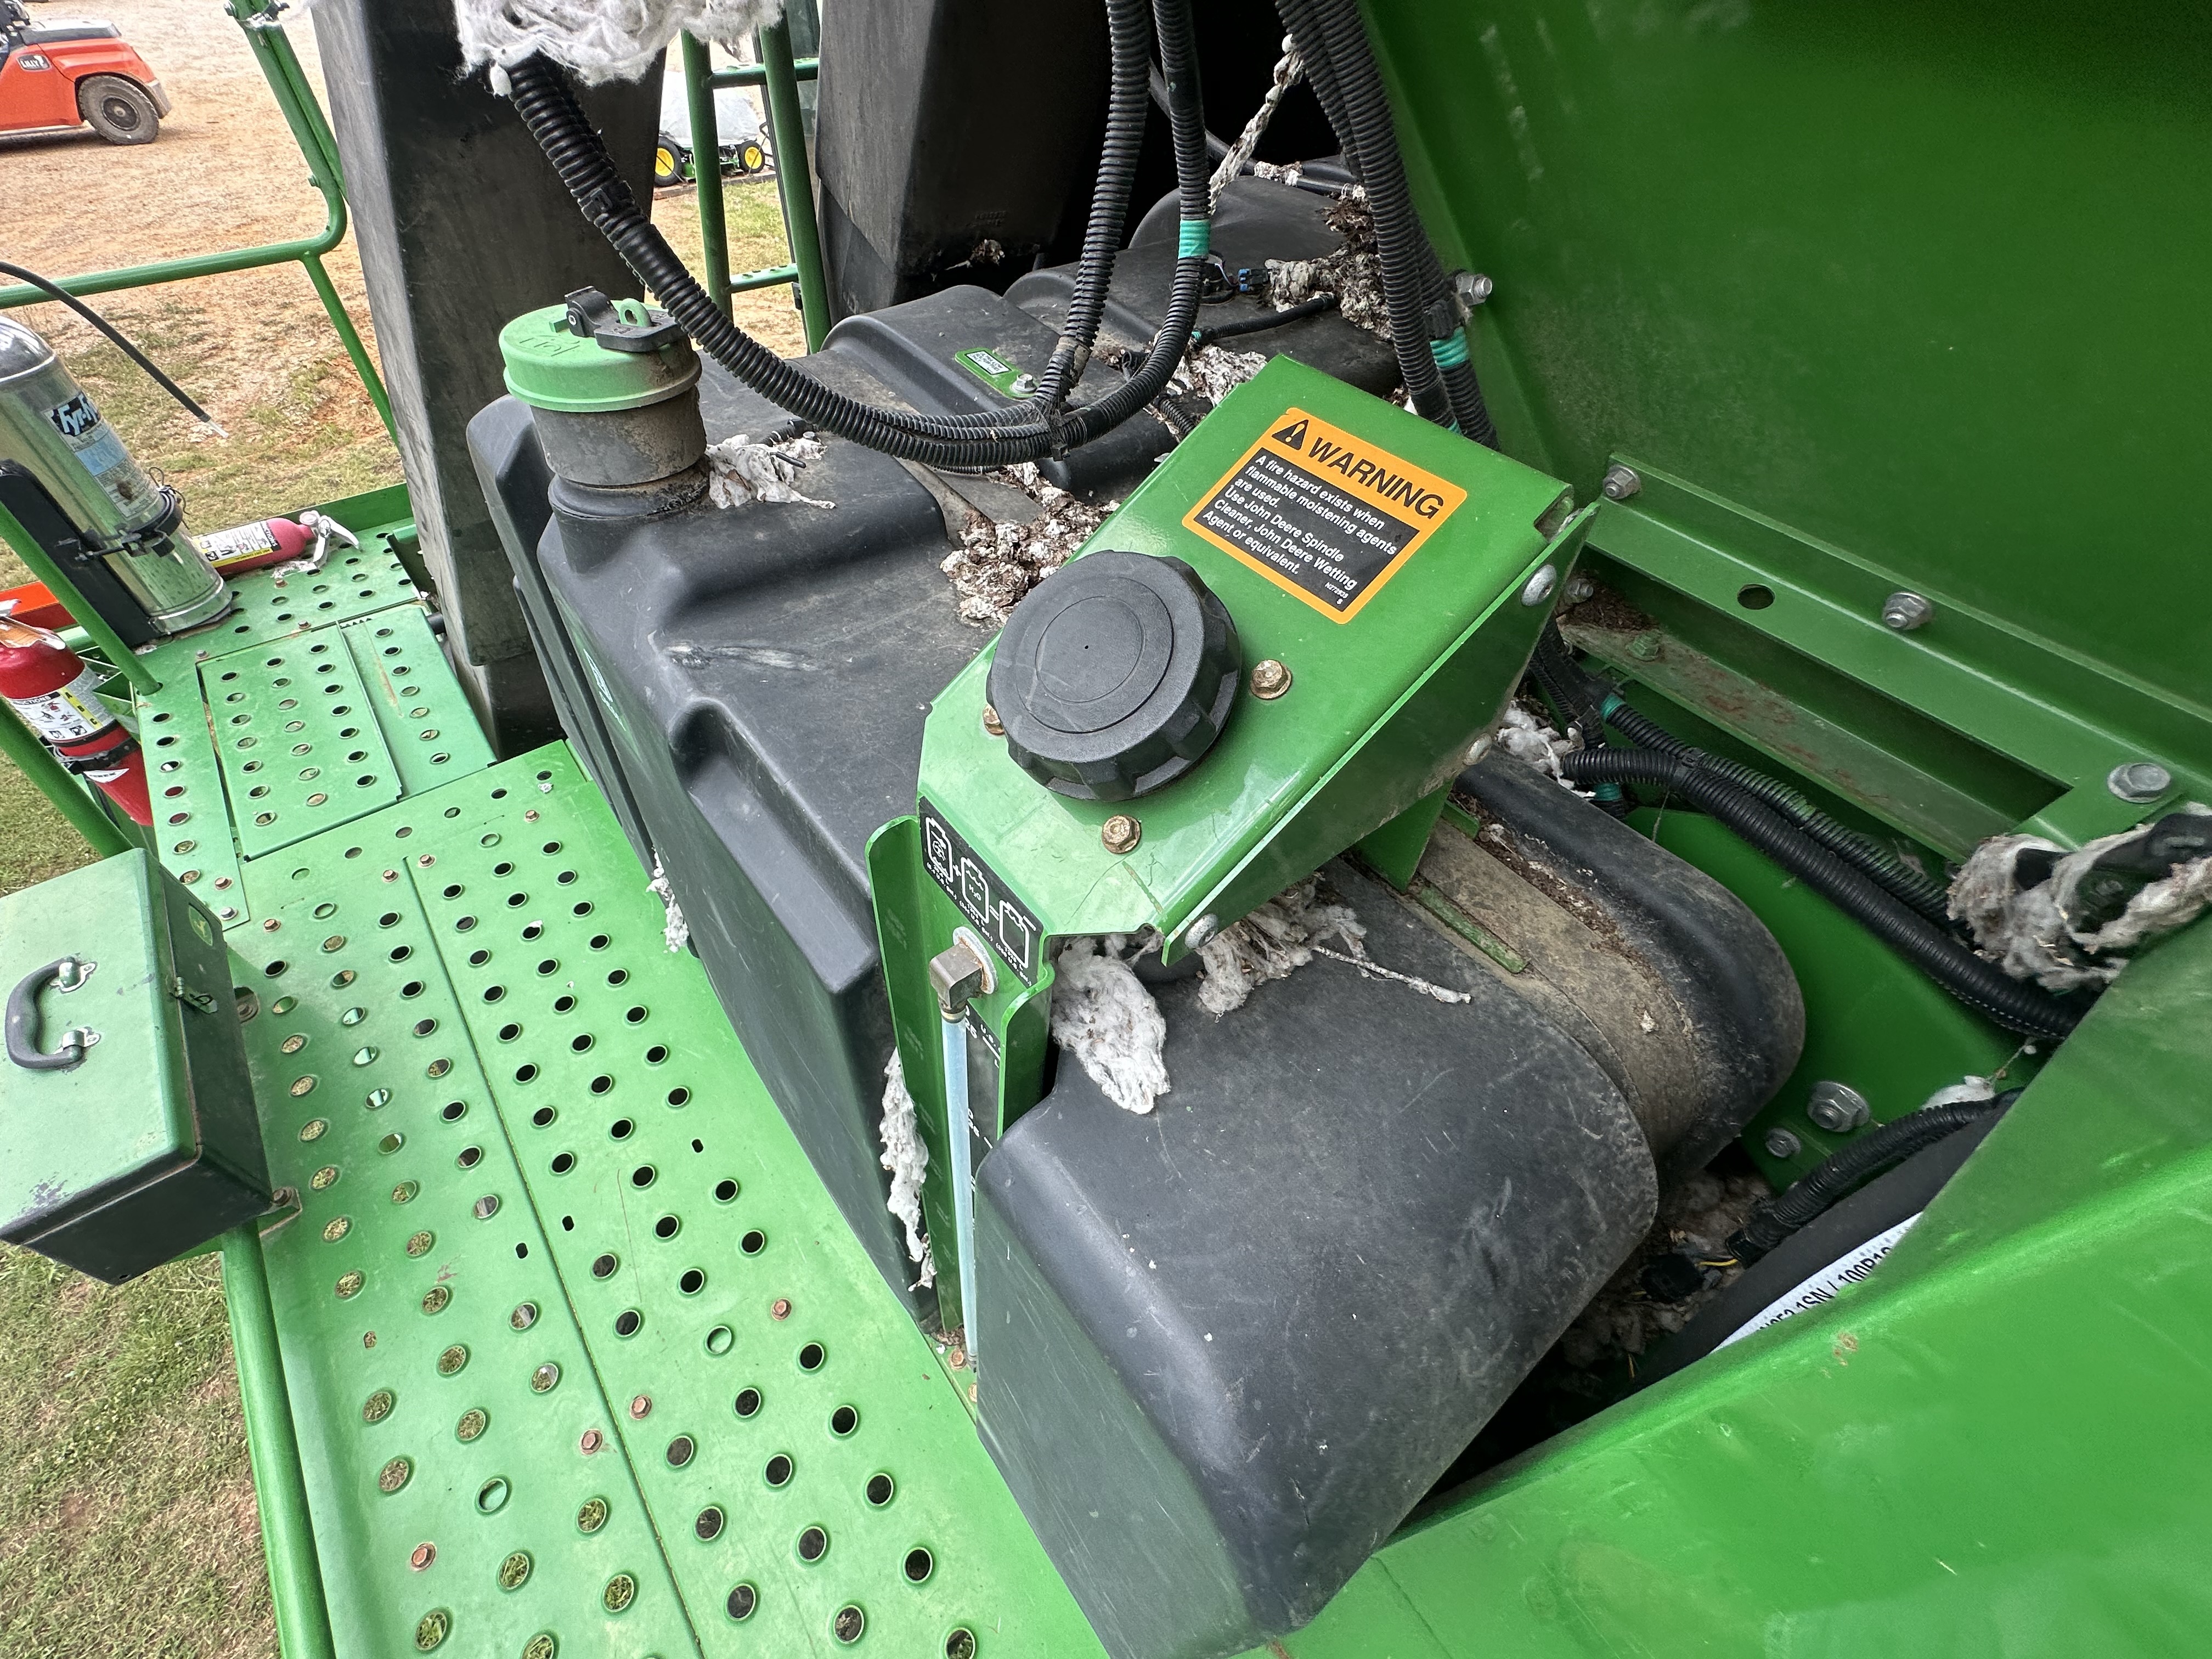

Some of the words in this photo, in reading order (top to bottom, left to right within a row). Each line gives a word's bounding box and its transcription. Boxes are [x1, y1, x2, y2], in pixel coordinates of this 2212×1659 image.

[1234, 478, 1252, 492] are
[1251, 487, 1281, 508] used.
[1245, 465, 1297, 500] flammable
[1296, 495, 1358, 535] moistening
[1356, 529, 1397, 555] agents
[1255, 455, 1267, 466] A
[1265, 460, 1284, 475] fire
[1283, 469, 1322, 495] hazard
[1319, 490, 1353, 512] exists
[1352, 507, 1385, 531] when
[1308, 437, 1444, 519] WARNING
[1203, 510, 1235, 534] Agent
[1232, 529, 1247, 540] or
[1244, 537, 1300, 574] equivalent.
[1214, 499, 1254, 529] Cleaner,
[1254, 523, 1282, 544] John
[1280, 538, 1313, 562] Deere
[1313, 556, 1358, 591] Wetting
[1224, 486, 1245, 505] Use
[1244, 500, 1272, 520] John
[1269, 514, 1302, 538] Deere
[1301, 532, 1344, 562] Spindle
